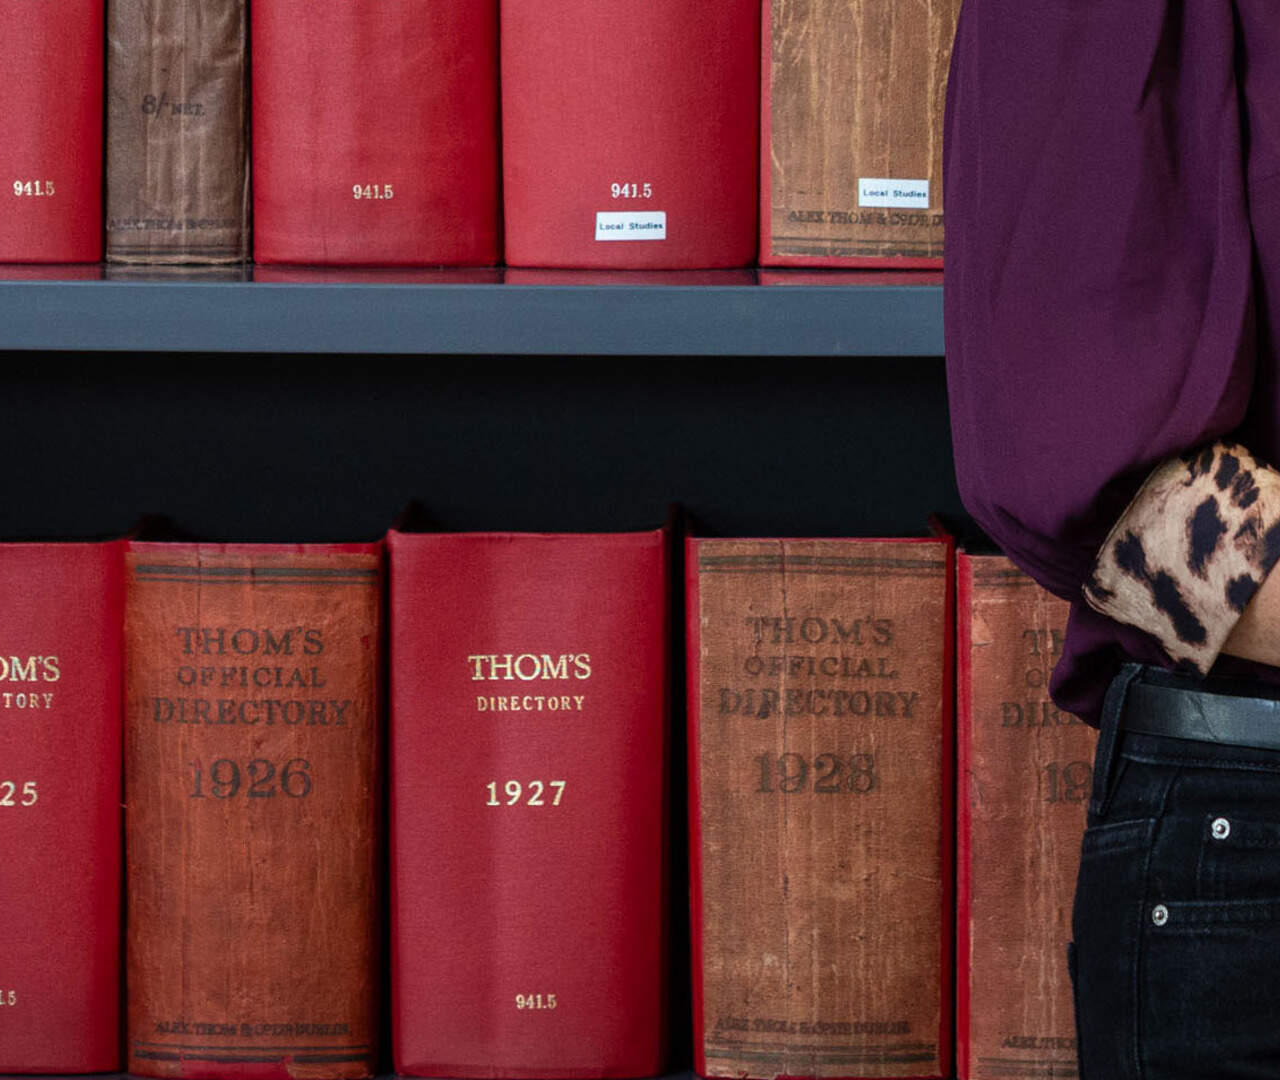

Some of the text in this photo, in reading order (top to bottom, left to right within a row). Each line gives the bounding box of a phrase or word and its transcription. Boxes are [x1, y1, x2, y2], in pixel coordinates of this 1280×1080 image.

[13, 180, 54, 196] 941.5
[353, 185, 393, 199] 941.5
[611, 183, 651, 198] 941.5
[863, 189, 927, 199] Local Studies
[599, 221, 663, 231] Local Studies
[176, 627, 326, 657] THOM'S
[745, 617, 896, 646] THOM'S
[177, 666, 327, 688] OFFICIAL
[468, 654, 591, 680] THOM'S
[744, 655, 898, 680] OFFICIAL
[153, 697, 354, 725] DIRECTORY
[477, 696, 584, 711] DIRECTORY
[722, 690, 919, 720] DIRECTORY
[187, 759, 313, 799] 1926
[754, 753, 880, 796] 1928
[487, 780, 565, 805] 1927
[516, 994, 556, 1009] 941.5
